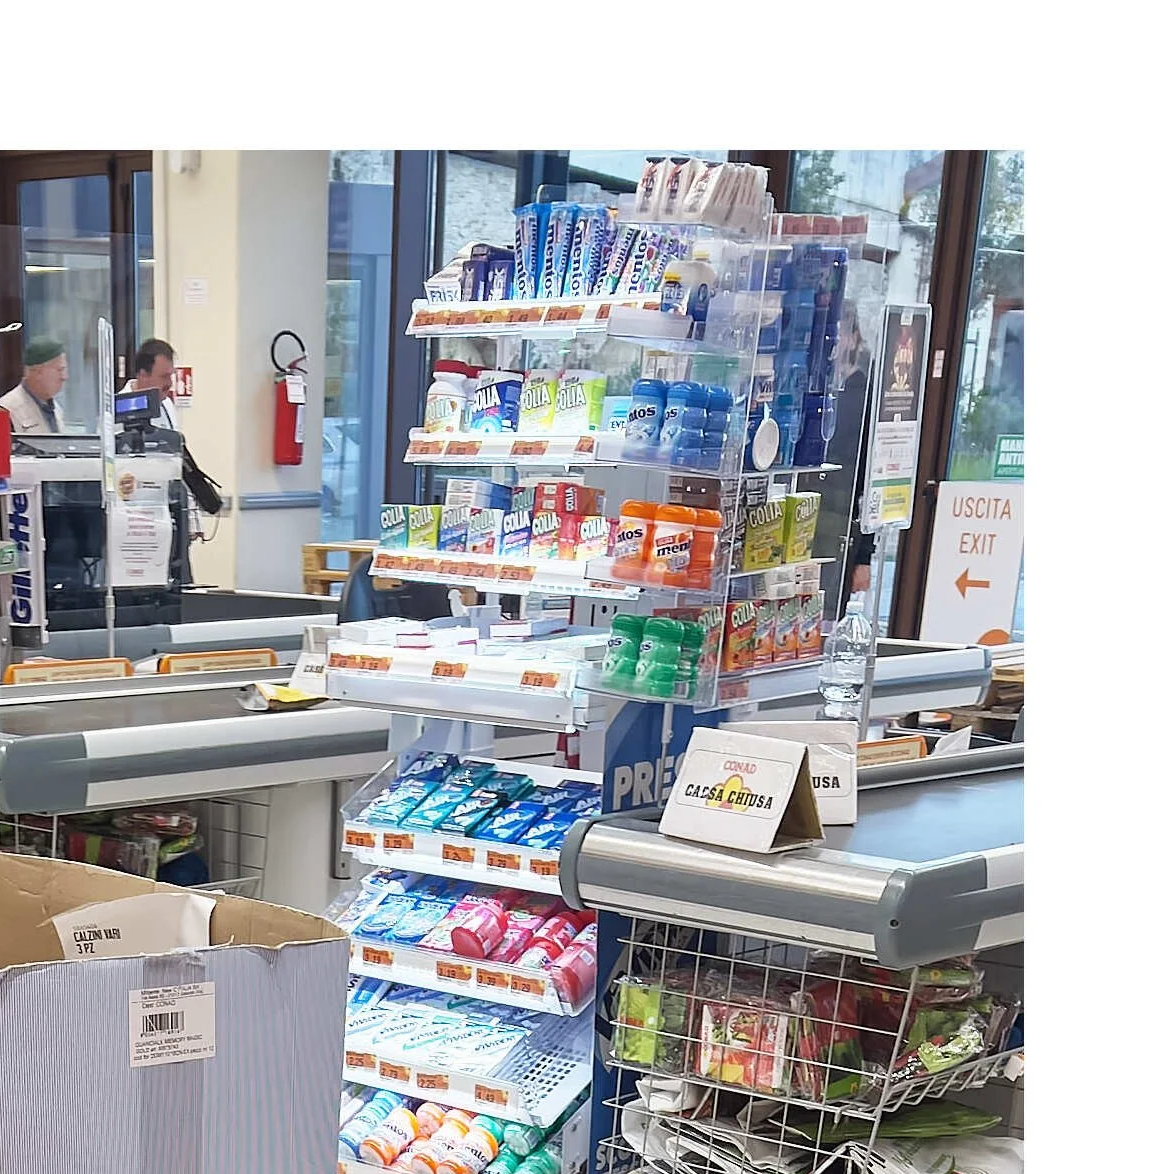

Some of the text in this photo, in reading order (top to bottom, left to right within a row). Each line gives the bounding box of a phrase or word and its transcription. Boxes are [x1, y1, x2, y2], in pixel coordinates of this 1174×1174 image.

[473, 383, 502, 412] OLIA
[953, 496, 1012, 519] USCITA
[959, 533, 997, 555] EXIT
[722, 759, 758, 775] CONAD
[811, 775, 841, 789] USA
[727, 790, 774, 810] CHIUSA
[76, 942, 95, 954] 3 PZ
